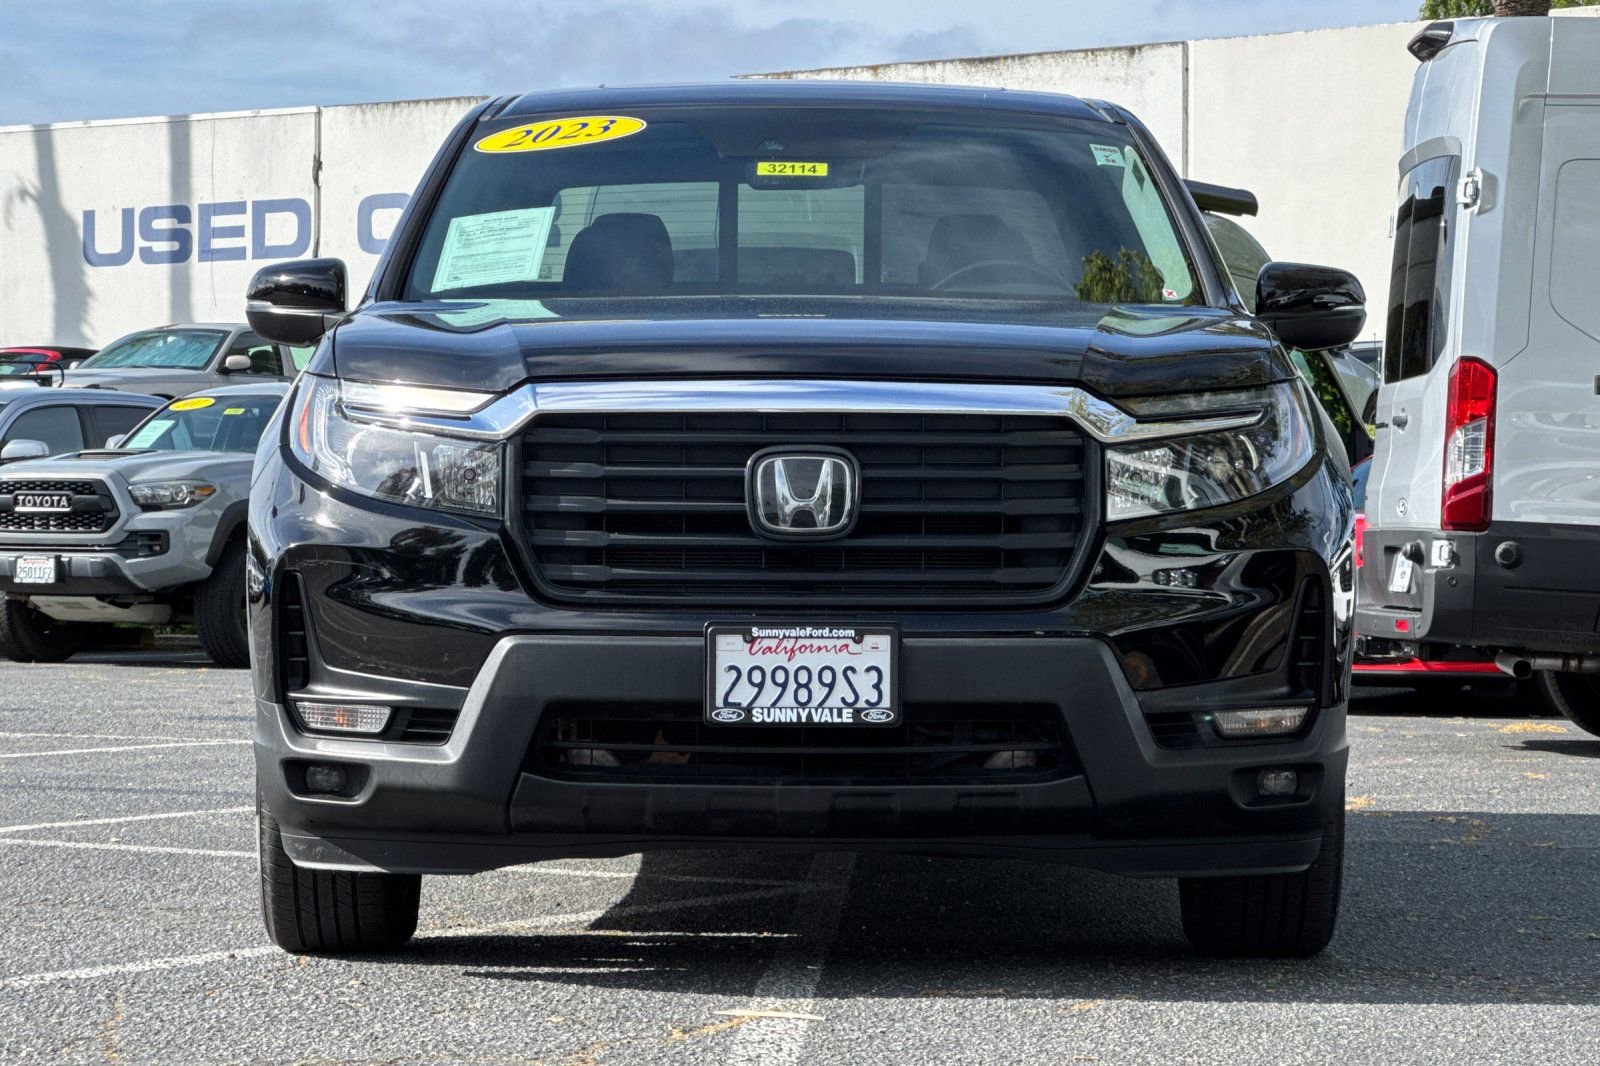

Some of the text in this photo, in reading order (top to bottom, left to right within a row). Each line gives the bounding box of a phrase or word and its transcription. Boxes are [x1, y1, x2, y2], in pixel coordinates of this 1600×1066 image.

[500, 119, 617, 149] 2023
[767, 163, 818, 174] 32114
[82, 197, 312, 268] USED
[17, 495, 69, 508] TOYOTA
[751, 626, 856, 639] SunnyvaleFord.com
[748, 637, 863, 663] California
[722, 664, 884, 708] 29989S3
[751, 707, 854, 723] SUNNYVALE
